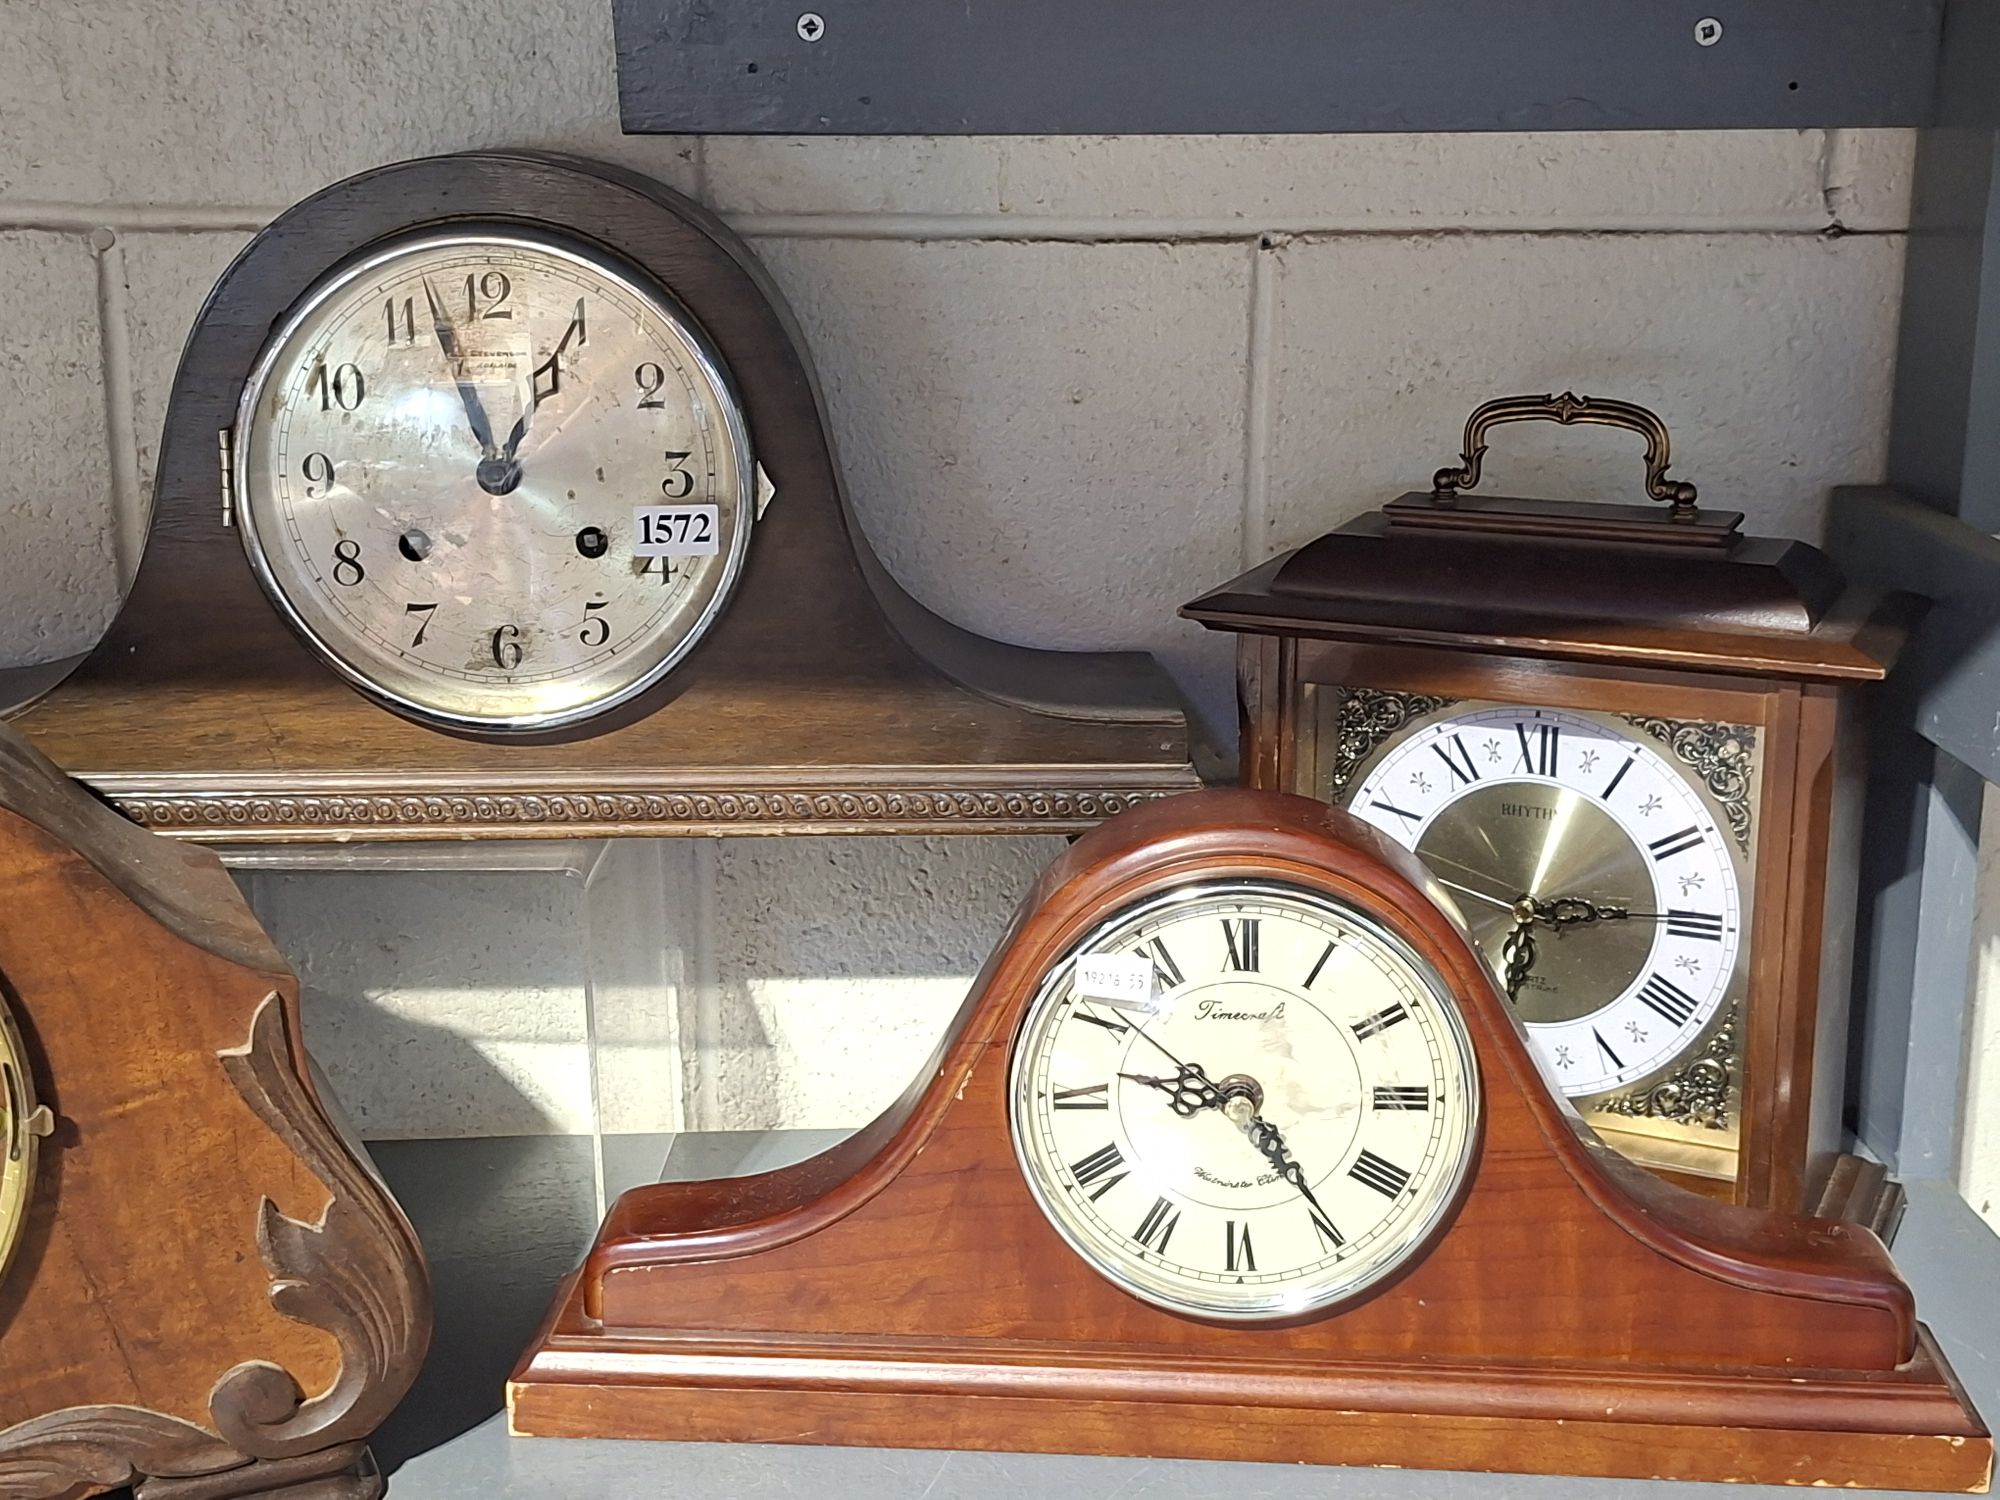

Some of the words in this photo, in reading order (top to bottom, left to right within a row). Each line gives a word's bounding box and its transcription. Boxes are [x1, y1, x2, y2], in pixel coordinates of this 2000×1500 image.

[462, 271, 512, 322] 12
[381, 296, 415, 346] 11
[573, 296, 590, 346] 1
[317, 362, 364, 411] 10
[635, 362, 665, 409] 2
[302, 452, 335, 499] 9
[661, 451, 694, 497] 3
[639, 513, 712, 545] 1572
[332, 539, 364, 586] 8
[405, 602, 438, 647] 7
[492, 624, 523, 669] 6
[580, 601, 609, 646] 5
[1431, 733, 1480, 792] XI
[1512, 723, 1559, 777] XII
[1601, 756, 1635, 801] I
[1370, 788, 1424, 835] X
[1502, 803, 1558, 820] RHYTH
[1649, 824, 1704, 861] II
[1221, 919, 1262, 972] XII
[1666, 909, 1723, 942] III
[1304, 940, 1339, 990] I
[1072, 1000, 1130, 1044] X
[1195, 1000, 1285, 1023] Timecraft
[1350, 1001, 1409, 1042] II
[1635, 972, 1699, 1029] IIII
[1591, 1024, 1627, 1076] V
[1054, 1083, 1109, 1111] IX
[1372, 1085, 1428, 1111] III
[1069, 1142, 1130, 1202] VIII
[1349, 1149, 1411, 1202] IIII
[1131, 1196, 1181, 1255] VII
[1224, 1220, 1257, 1272] VI
[1308, 1208, 1345, 1253] V
